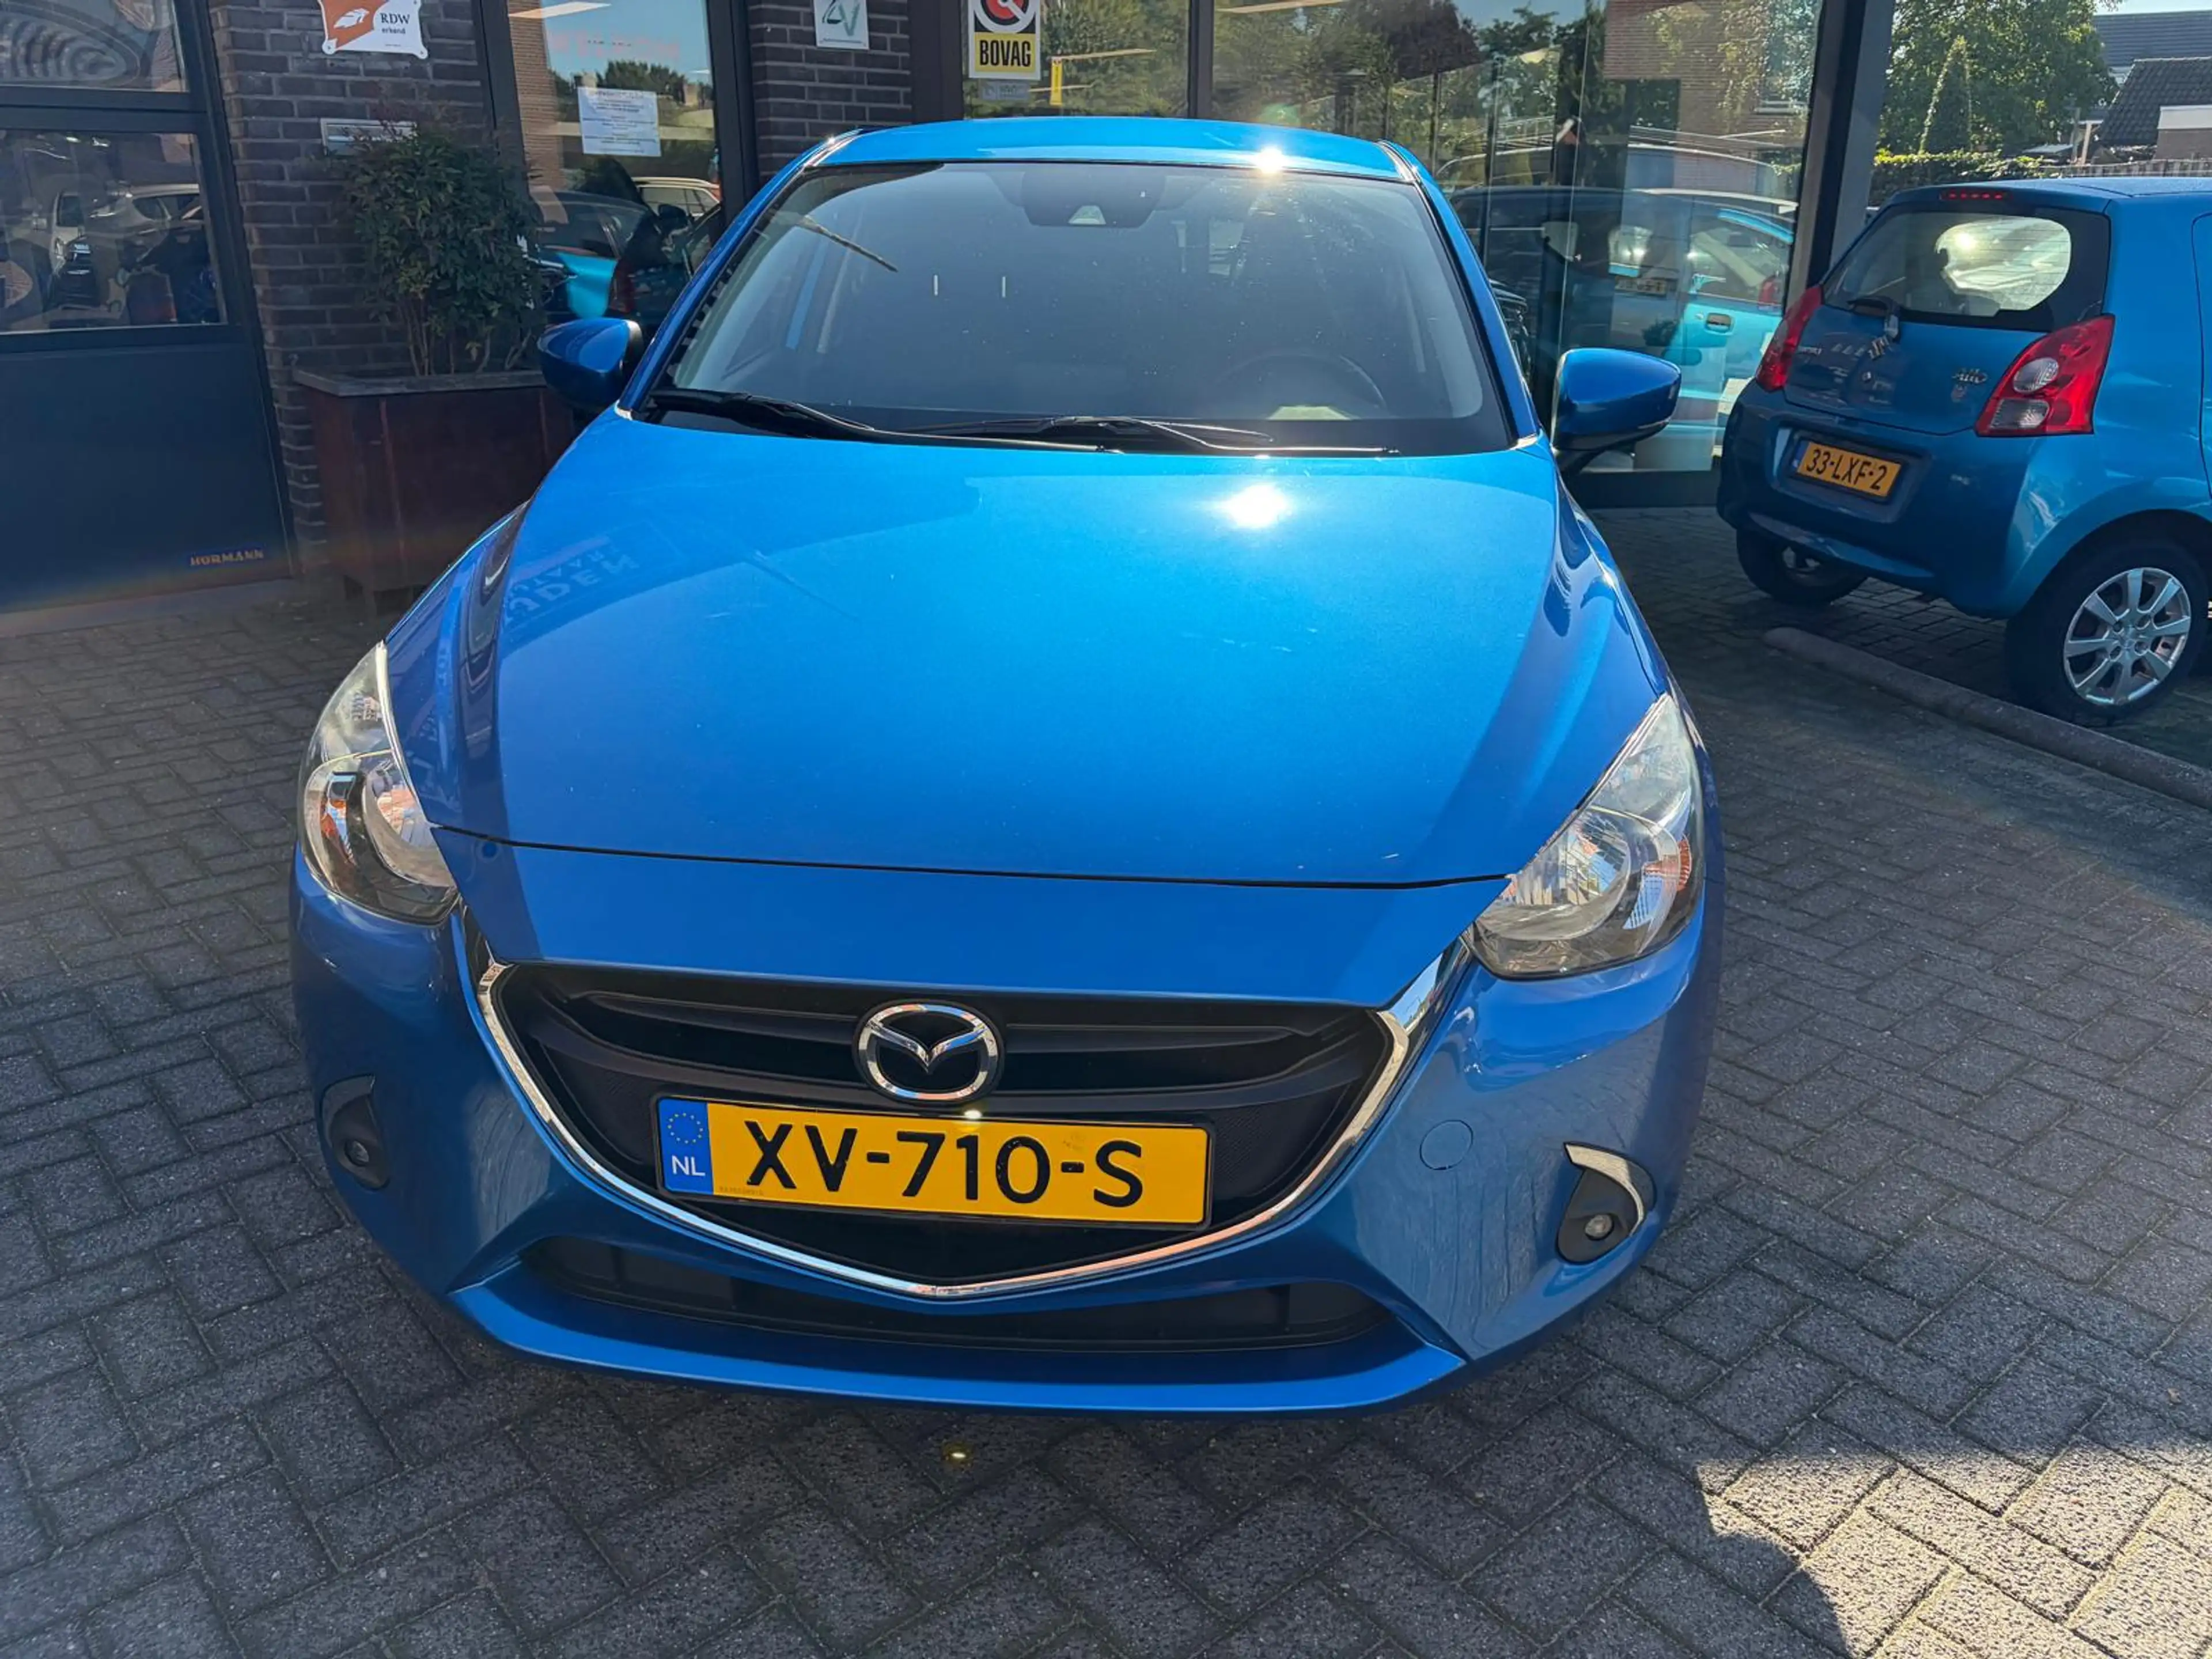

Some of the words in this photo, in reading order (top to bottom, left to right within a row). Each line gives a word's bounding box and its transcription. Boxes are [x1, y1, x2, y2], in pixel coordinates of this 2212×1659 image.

[380, 13, 410, 24] RDW
[980, 40, 1031, 67] BOVAG
[1806, 449, 1888, 490] 33-LXF-2
[671, 1154, 706, 1176] NL
[744, 1120, 1143, 1208] XV-710-S
